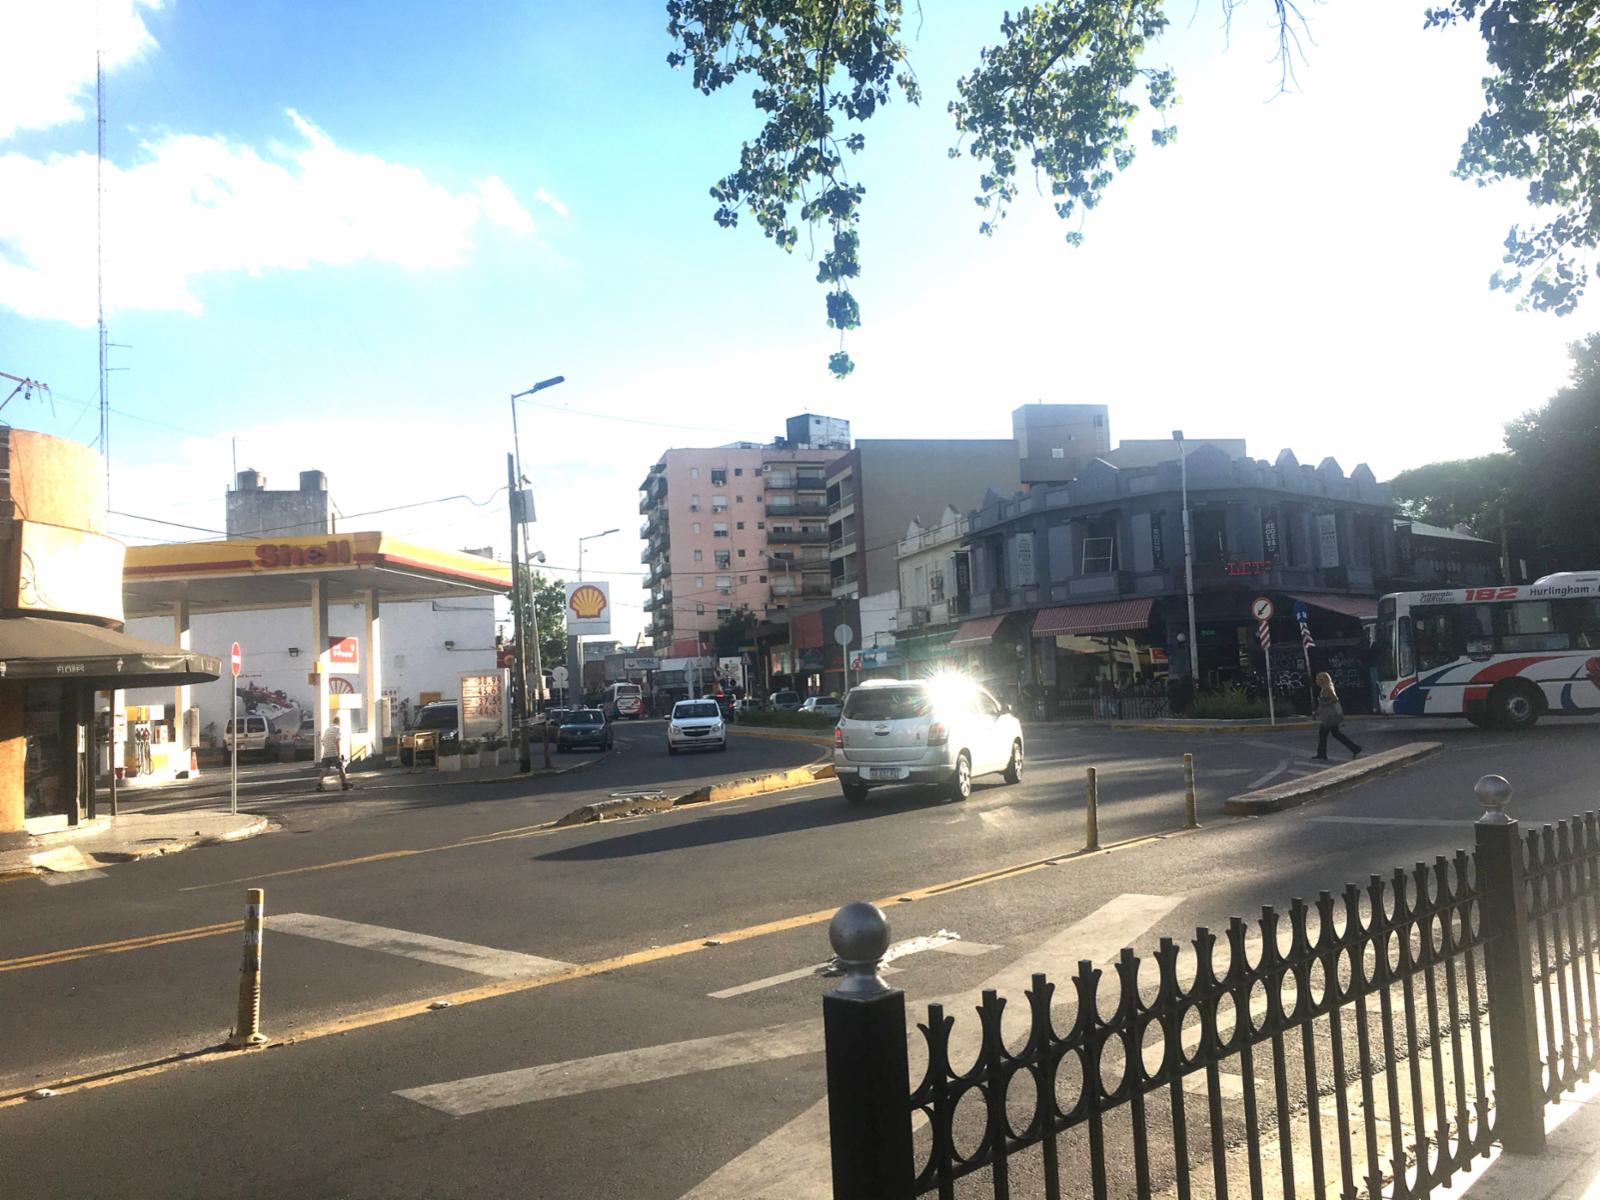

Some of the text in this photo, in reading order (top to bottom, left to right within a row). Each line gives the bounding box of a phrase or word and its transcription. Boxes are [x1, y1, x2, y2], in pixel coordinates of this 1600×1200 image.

[255, 540, 351, 567] Shell
[1465, 587, 1519, 601] 182
[1529, 585, 1589, 596] Hurlingham
